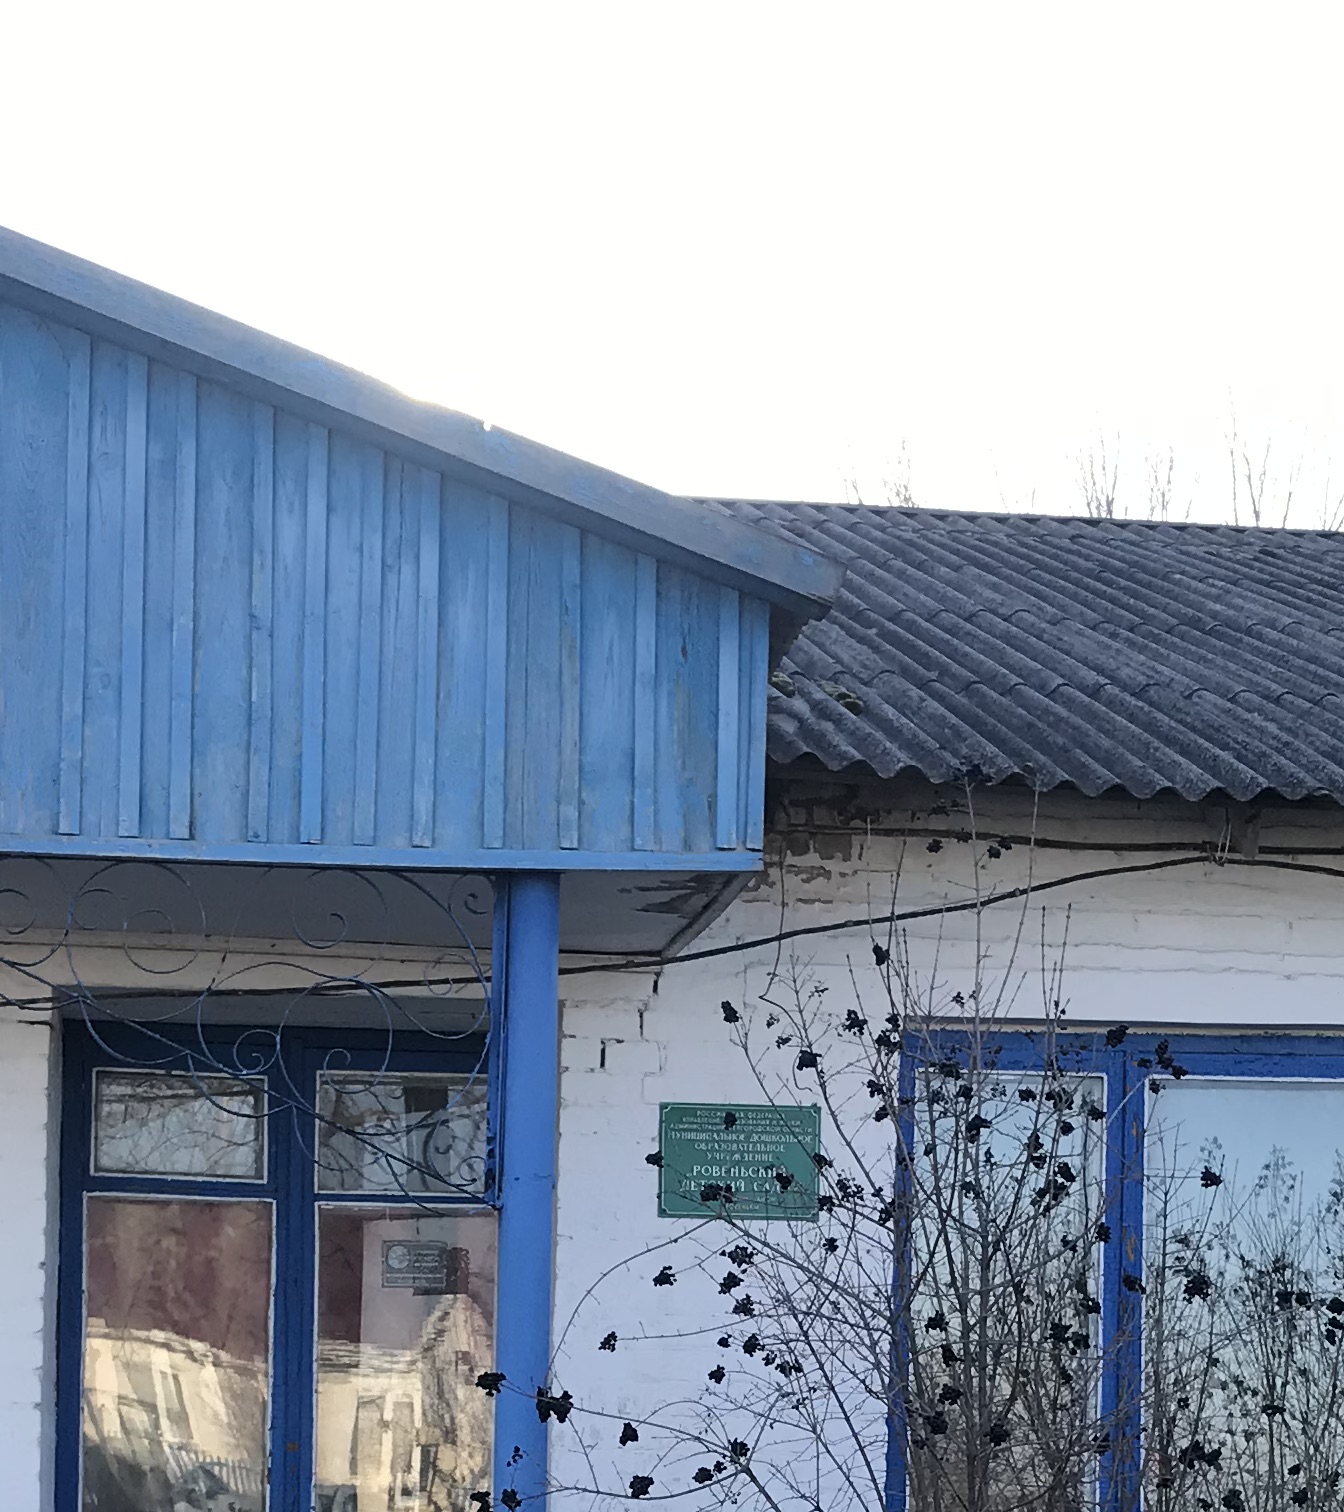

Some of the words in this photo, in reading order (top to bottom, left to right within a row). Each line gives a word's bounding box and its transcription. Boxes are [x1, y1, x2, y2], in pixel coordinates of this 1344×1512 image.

[696, 1110, 744, 1118] РОССИАЯ
[667, 1131, 745, 1141] МУНИЦИПАЛЬНОЕ
[694, 1142, 786, 1152] ОБРАЗОВАТЕЛЬНОЕ
[706, 1151, 774, 1162] УЧРЕЖДЕНИЕ
[679, 1179, 746, 1192] ДЕТИЙ
